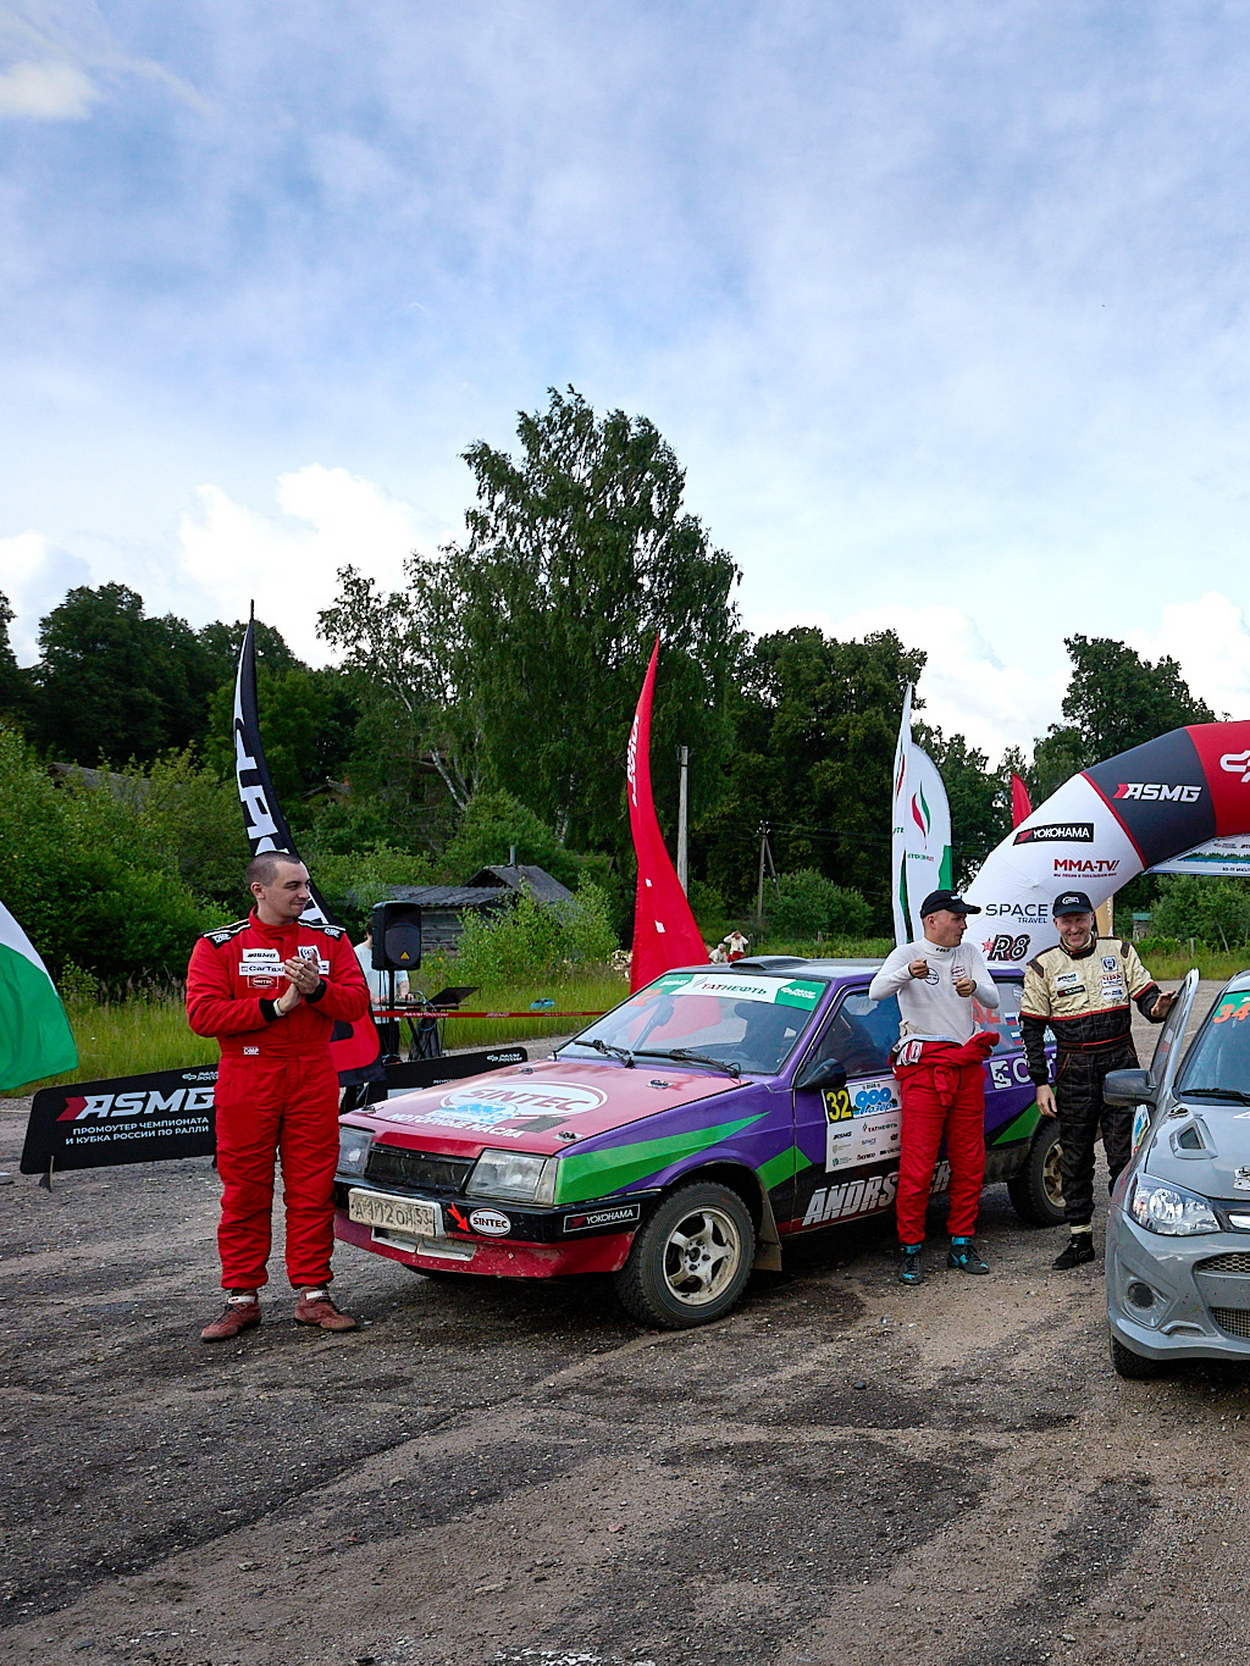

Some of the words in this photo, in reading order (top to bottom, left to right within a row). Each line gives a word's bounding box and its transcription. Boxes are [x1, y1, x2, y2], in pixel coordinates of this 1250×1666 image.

[1122, 784, 1201, 802] ASMG
[1033, 828, 1089, 838] YOKOHAMA
[986, 904, 1048, 916] SPACE
[988, 934, 1031, 961] R8
[701, 983, 767, 995] ТАТНЕФТЬ
[74, 1086, 215, 1120] ASMG
[463, 1089, 590, 1111] SINTEC
[826, 1090, 852, 1120] 32
[855, 1087, 892, 1114] 900
[72, 1123, 137, 1135] ПРОМОУТЕР
[139, 1117, 209, 1128] ЧЕМПИОНАТА
[76, 1135, 111, 1144] КУБКА
[113, 1131, 156, 1141] РОССИИ
[175, 1126, 209, 1135] РАЛЛИ
[473, 1218, 508, 1229] SINTEC
[586, 1210, 633, 1225] YOKOHAMA
